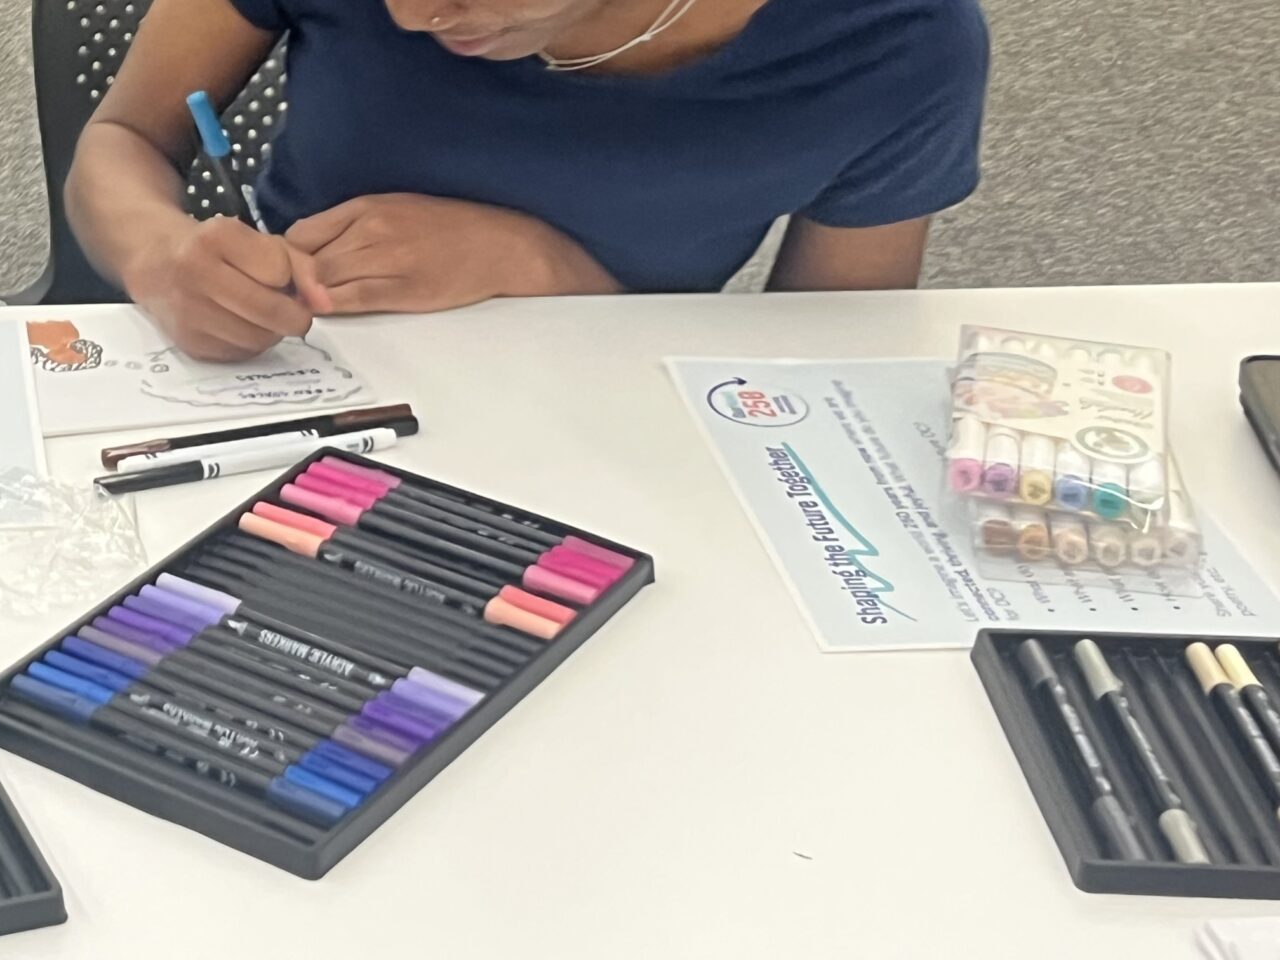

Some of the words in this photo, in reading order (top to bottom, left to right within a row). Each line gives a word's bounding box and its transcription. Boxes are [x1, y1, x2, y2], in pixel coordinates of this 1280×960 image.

[765, 446, 813, 498] Together
[798, 500, 840, 542] Future
[824, 544, 856, 567] the
[832, 569, 888, 625] Shaping
[258, 628, 310, 660] MARKERS
[308, 647, 355, 677] ACRYLIC
